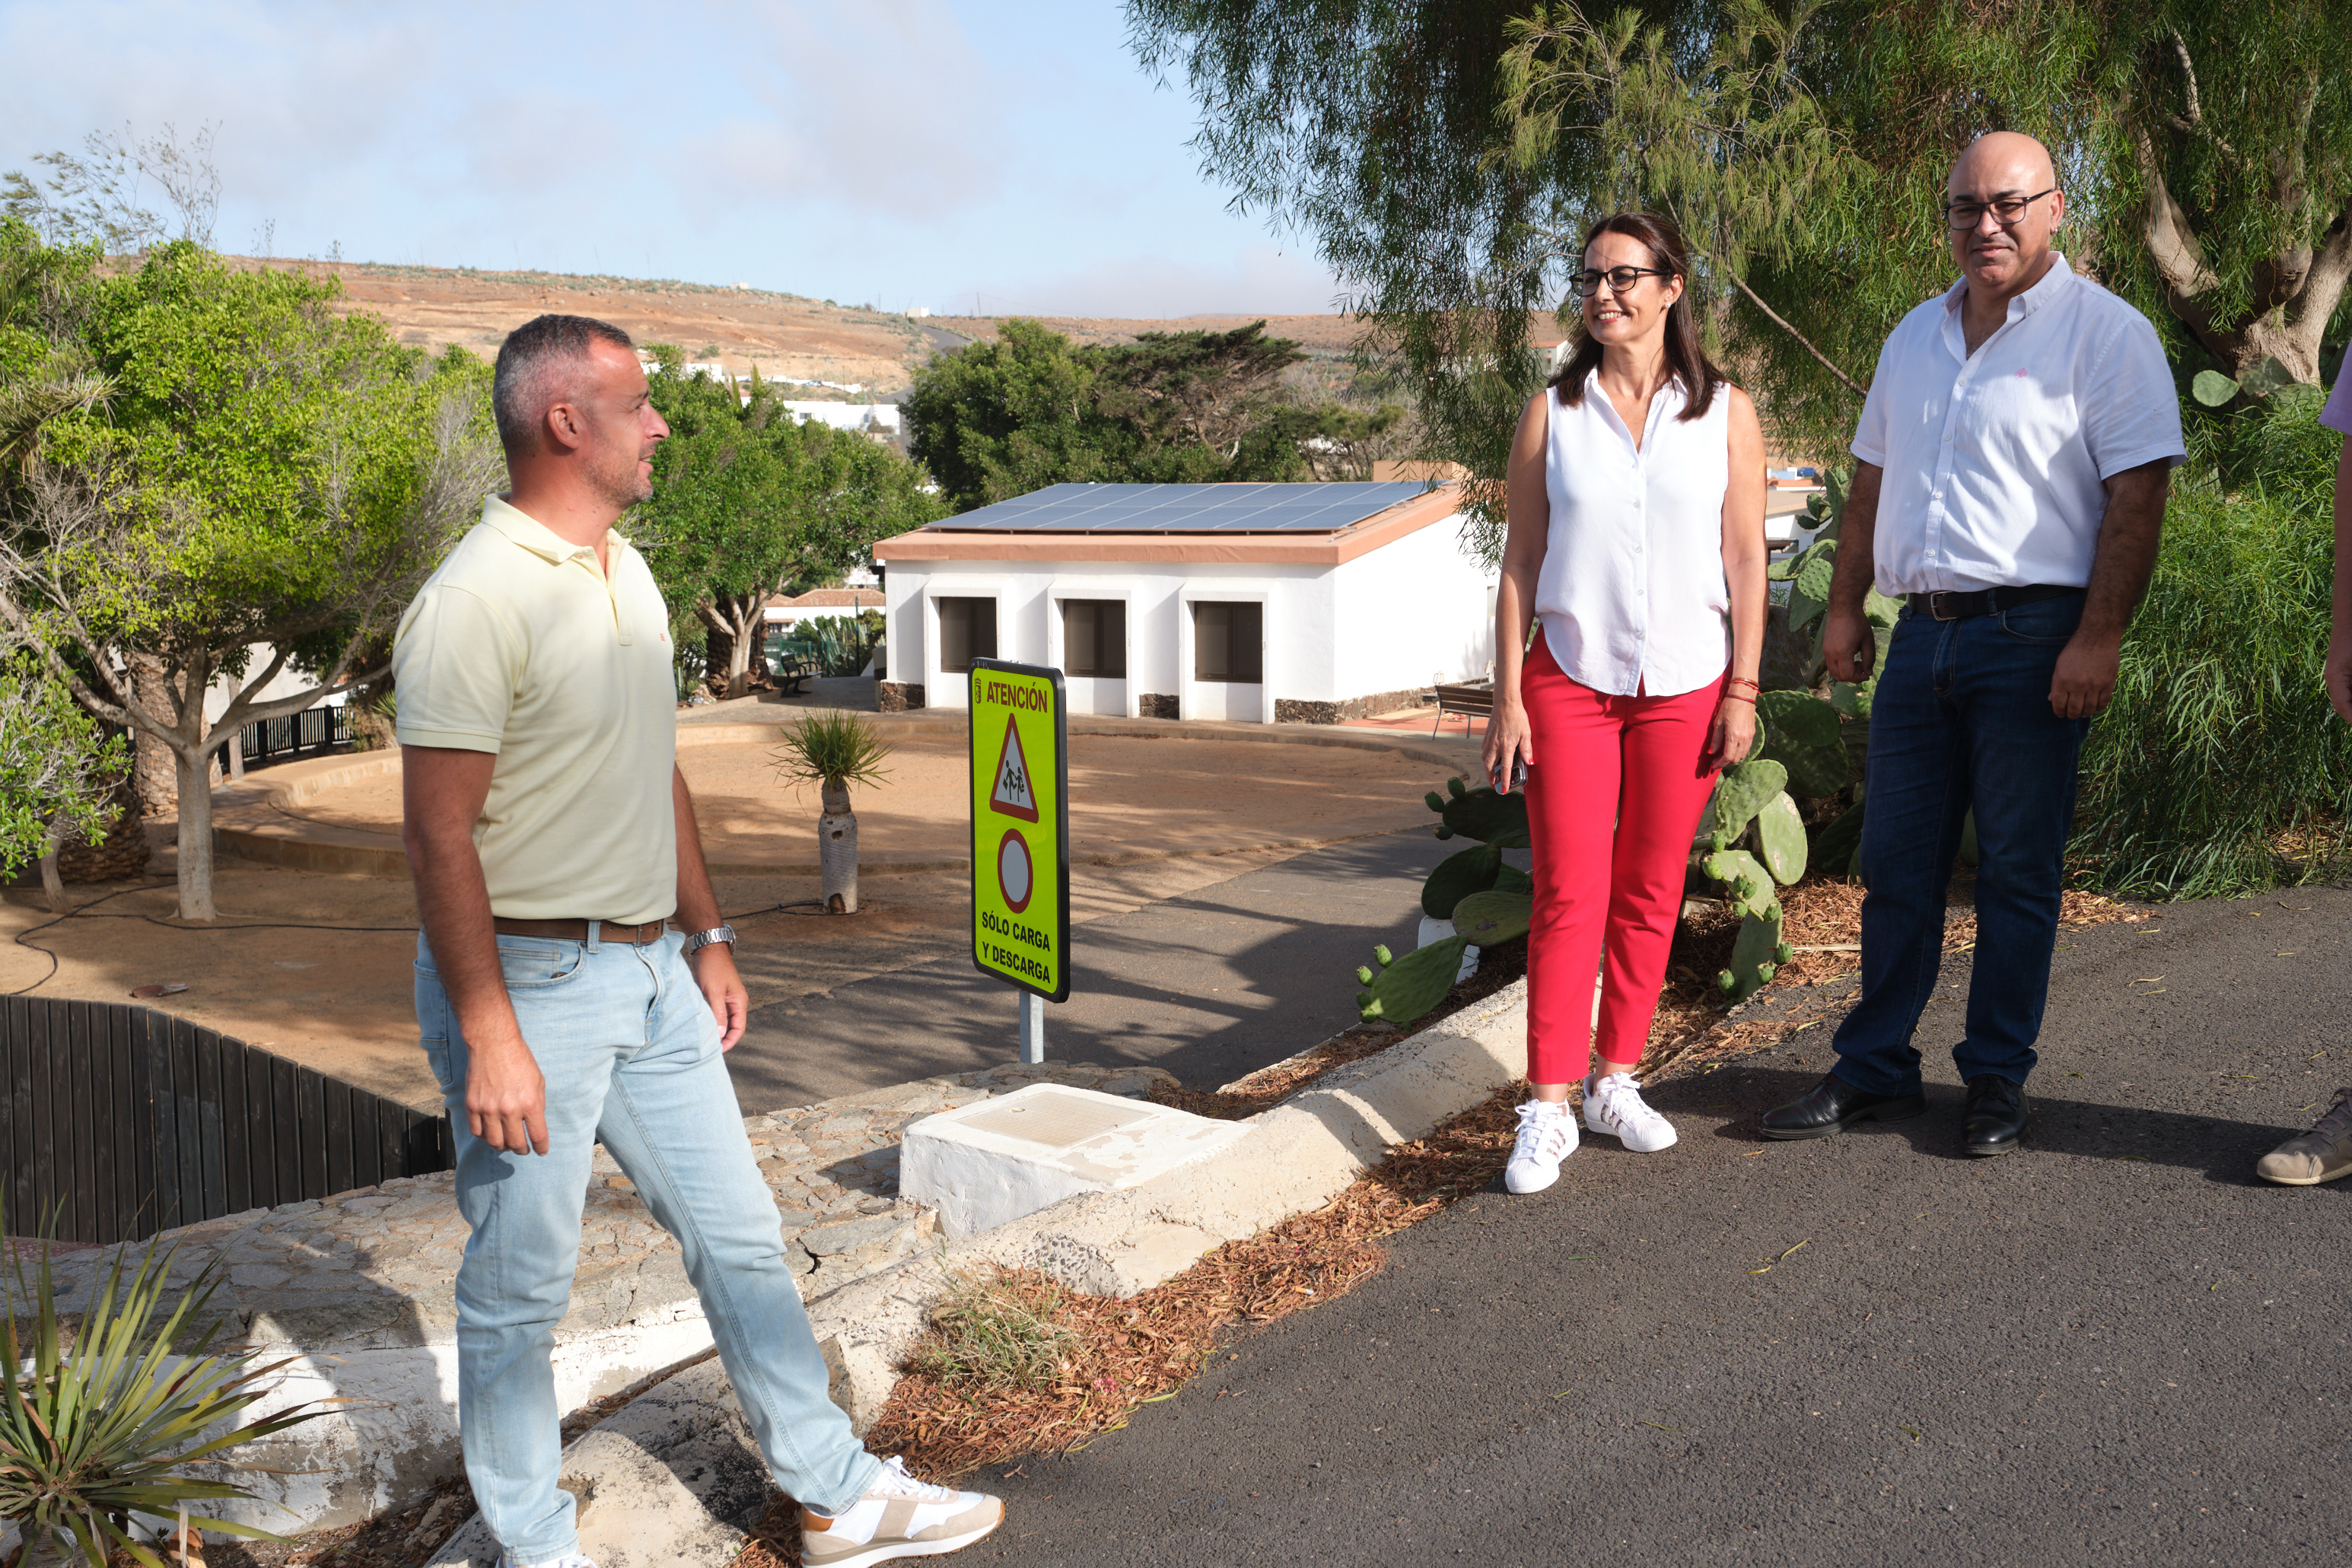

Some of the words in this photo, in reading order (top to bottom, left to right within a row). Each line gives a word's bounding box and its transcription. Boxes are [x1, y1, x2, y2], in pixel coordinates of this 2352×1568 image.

[987, 682, 1047, 713] ATENCIÓN
[982, 911, 1010, 936] SÓLO
[1013, 923, 1050, 952] CARGA
[982, 941, 989, 959] Y
[992, 945, 1050, 984] DESCARGA
